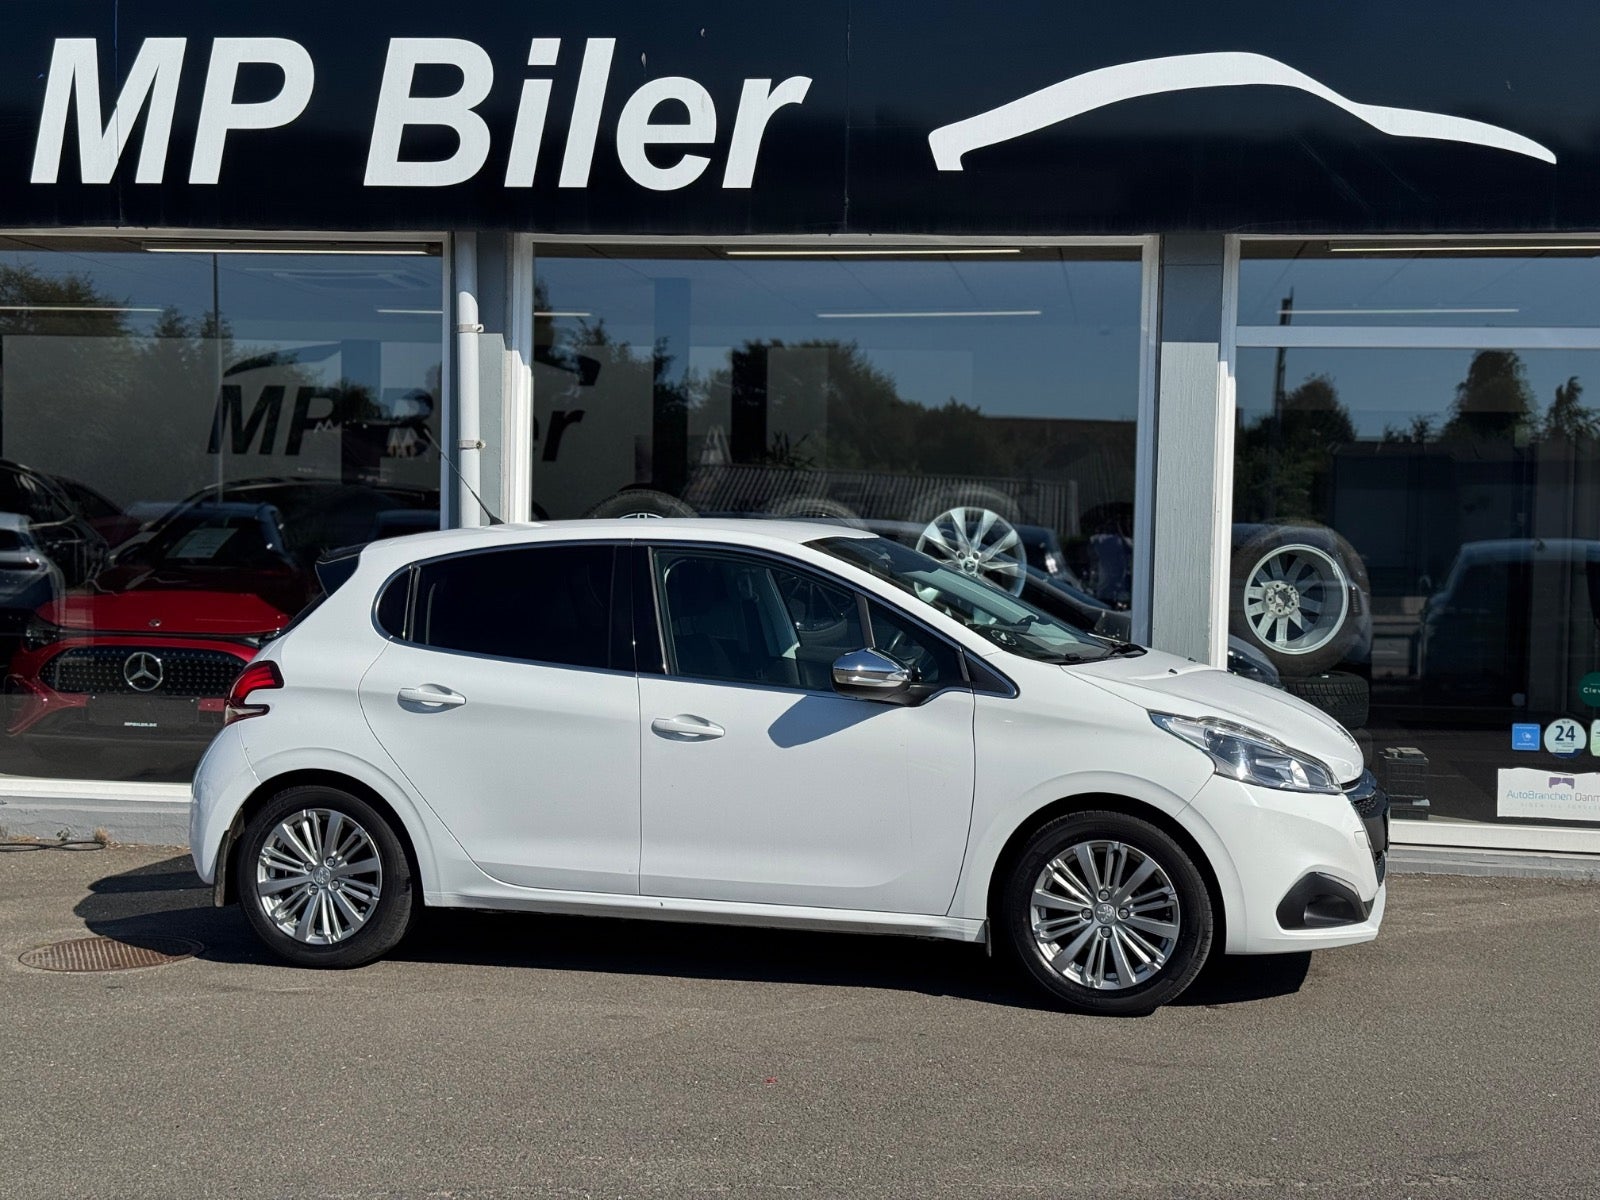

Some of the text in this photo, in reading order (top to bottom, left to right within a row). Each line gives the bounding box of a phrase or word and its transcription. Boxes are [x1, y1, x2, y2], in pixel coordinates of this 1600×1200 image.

[31, 38, 812, 191] MP Biler
[207, 385, 341, 456] MP
[1555, 725, 1576, 742] 24
[1506, 790, 1572, 801] AutoBranchen
